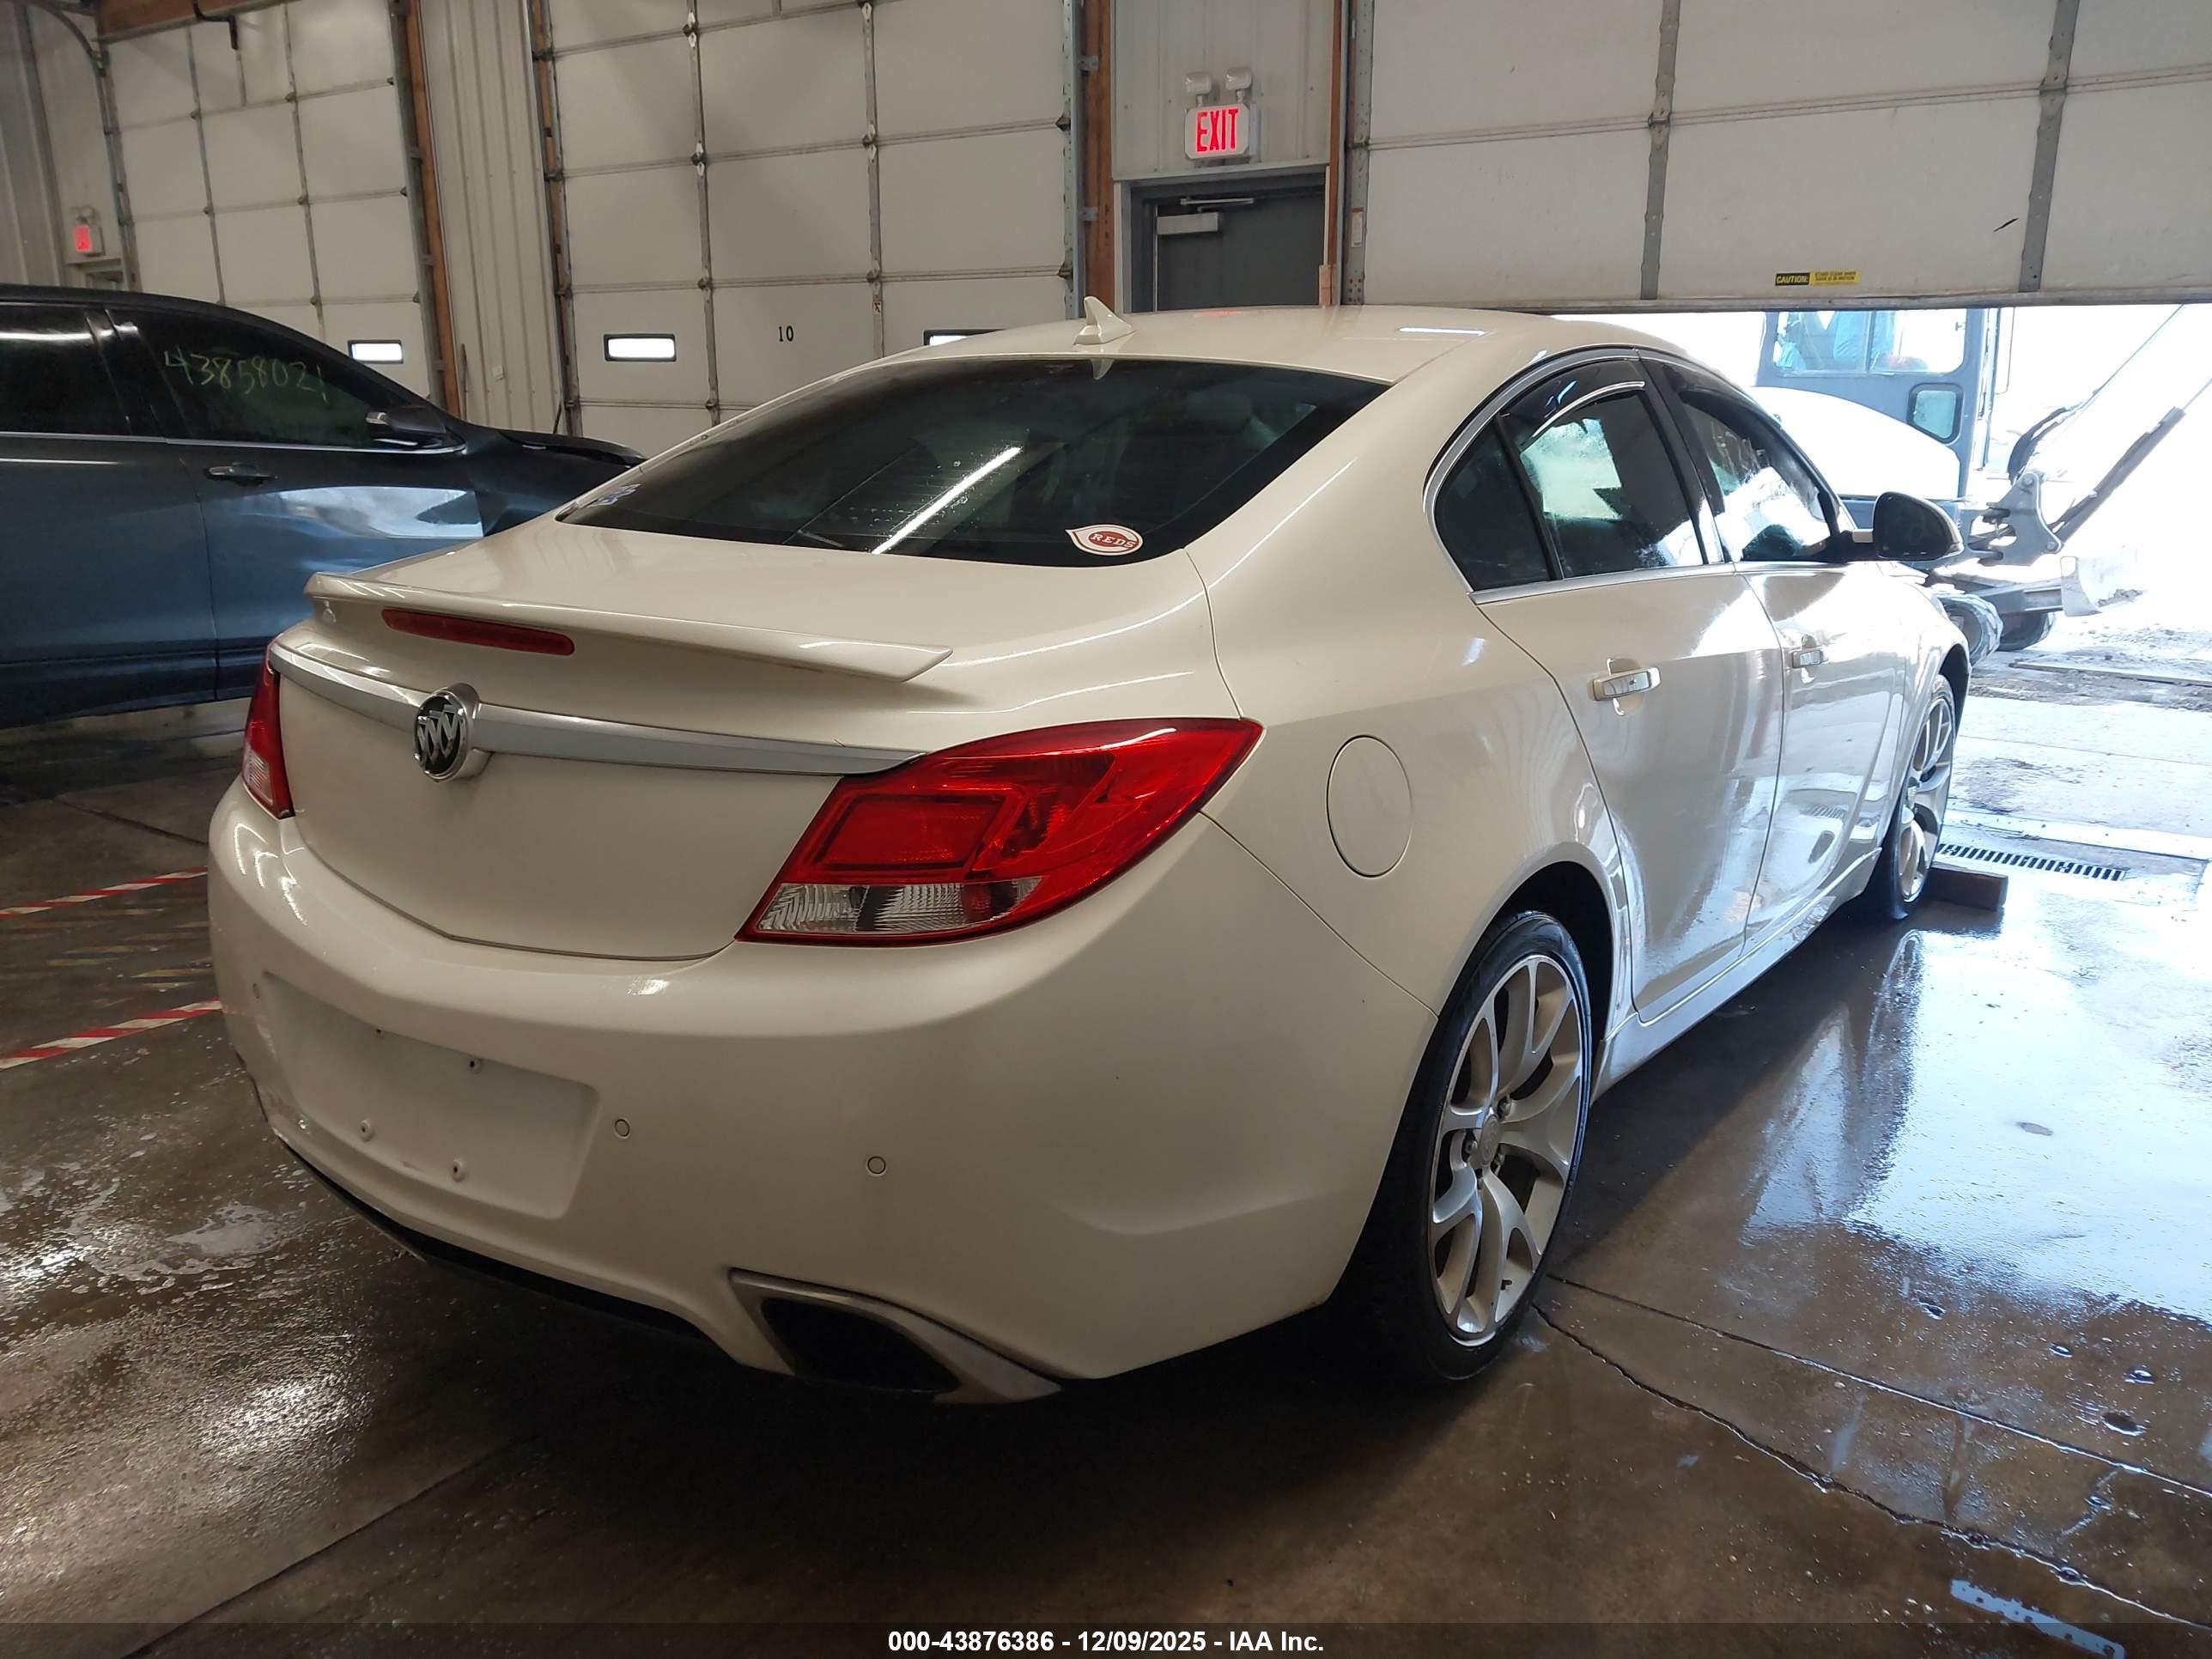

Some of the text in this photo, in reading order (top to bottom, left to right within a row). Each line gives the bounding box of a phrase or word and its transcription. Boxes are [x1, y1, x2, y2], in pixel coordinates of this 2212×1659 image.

[1196, 109, 1238, 152] EXIT
[779, 325, 793, 342] 10
[164, 345, 329, 404] 43858021
[1091, 533, 1137, 548] REDS
